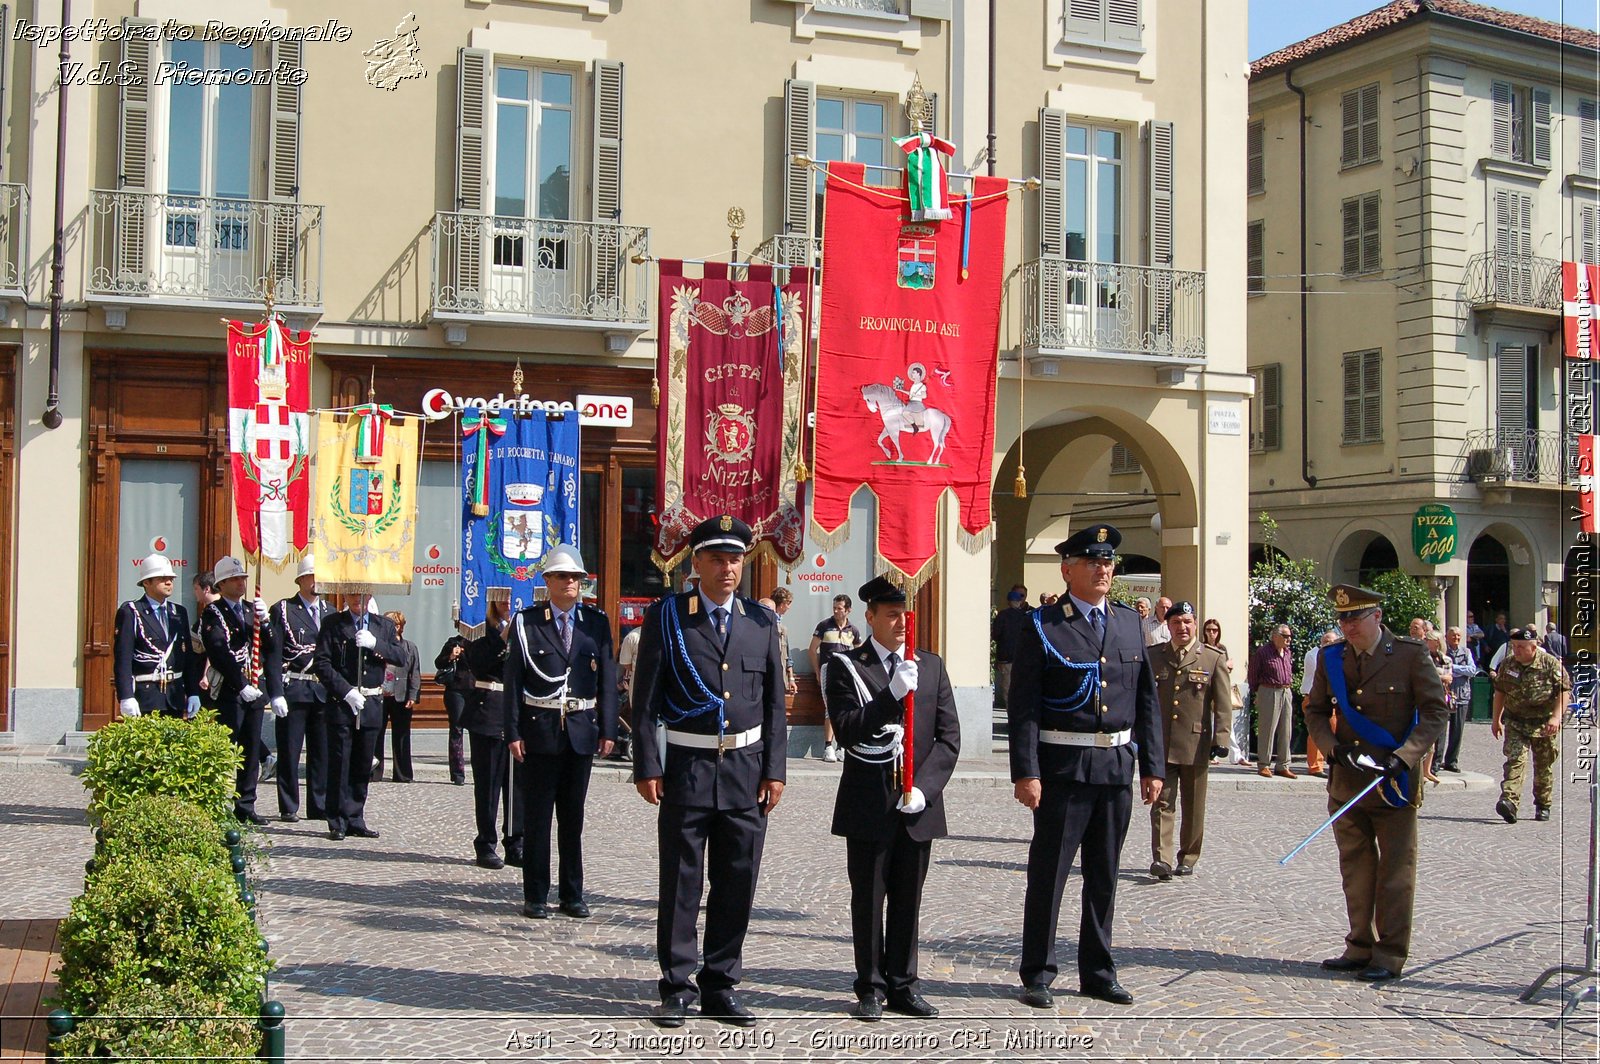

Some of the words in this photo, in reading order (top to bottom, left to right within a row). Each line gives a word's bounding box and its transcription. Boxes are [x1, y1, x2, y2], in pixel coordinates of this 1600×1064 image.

[860, 316, 921, 332] PROVINCIA
[925, 320, 937, 333] DI
[940, 322, 960, 337] ASTI
[704, 363, 761, 382] CITTÀ
[585, 402, 627, 419] one
[1213, 410, 1236, 418] PIAZZA
[498, 447, 505, 458] DI
[507, 447, 545, 460] ROCCHETTA
[549, 451, 575, 467] TANARO
[1417, 515, 1453, 526] PIZZA
[1427, 527, 1438, 538] A
[413, 564, 460, 575] odafone
[423, 578, 445, 586] one
[797, 571, 843, 582] vodafone
